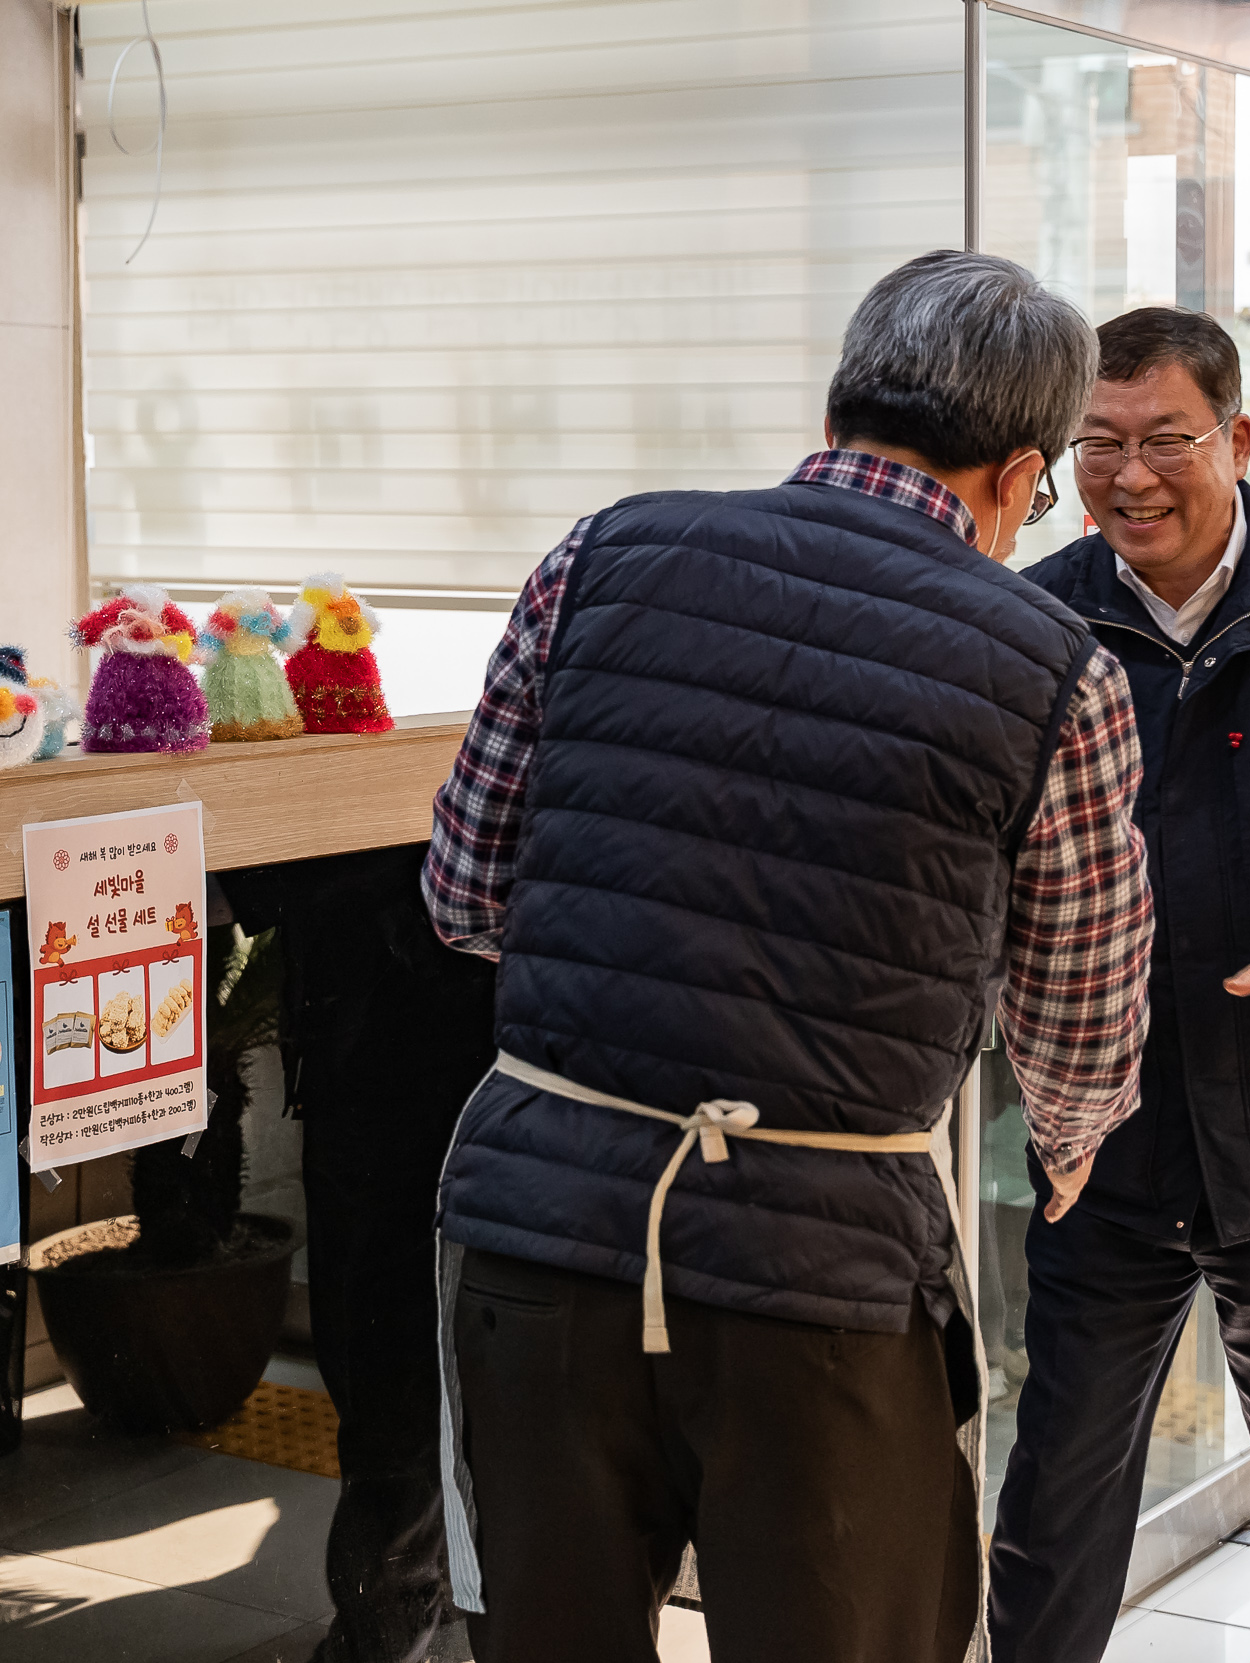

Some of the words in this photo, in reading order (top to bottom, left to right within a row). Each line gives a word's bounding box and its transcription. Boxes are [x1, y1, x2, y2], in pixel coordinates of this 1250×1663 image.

[79, 850, 98, 862] 새해
[99, 847, 106, 861] 복
[108, 846, 125, 860] 많이
[127, 842, 157, 857] 받으세요
[93, 869, 145, 899] 세빛마을
[87, 914, 100, 938] 설
[105, 908, 128, 933] 선물
[133, 906, 157, 926] 세트
[40, 1112, 64, 1127] 큰상자
[40, 1130, 73, 1146] 작은상자
